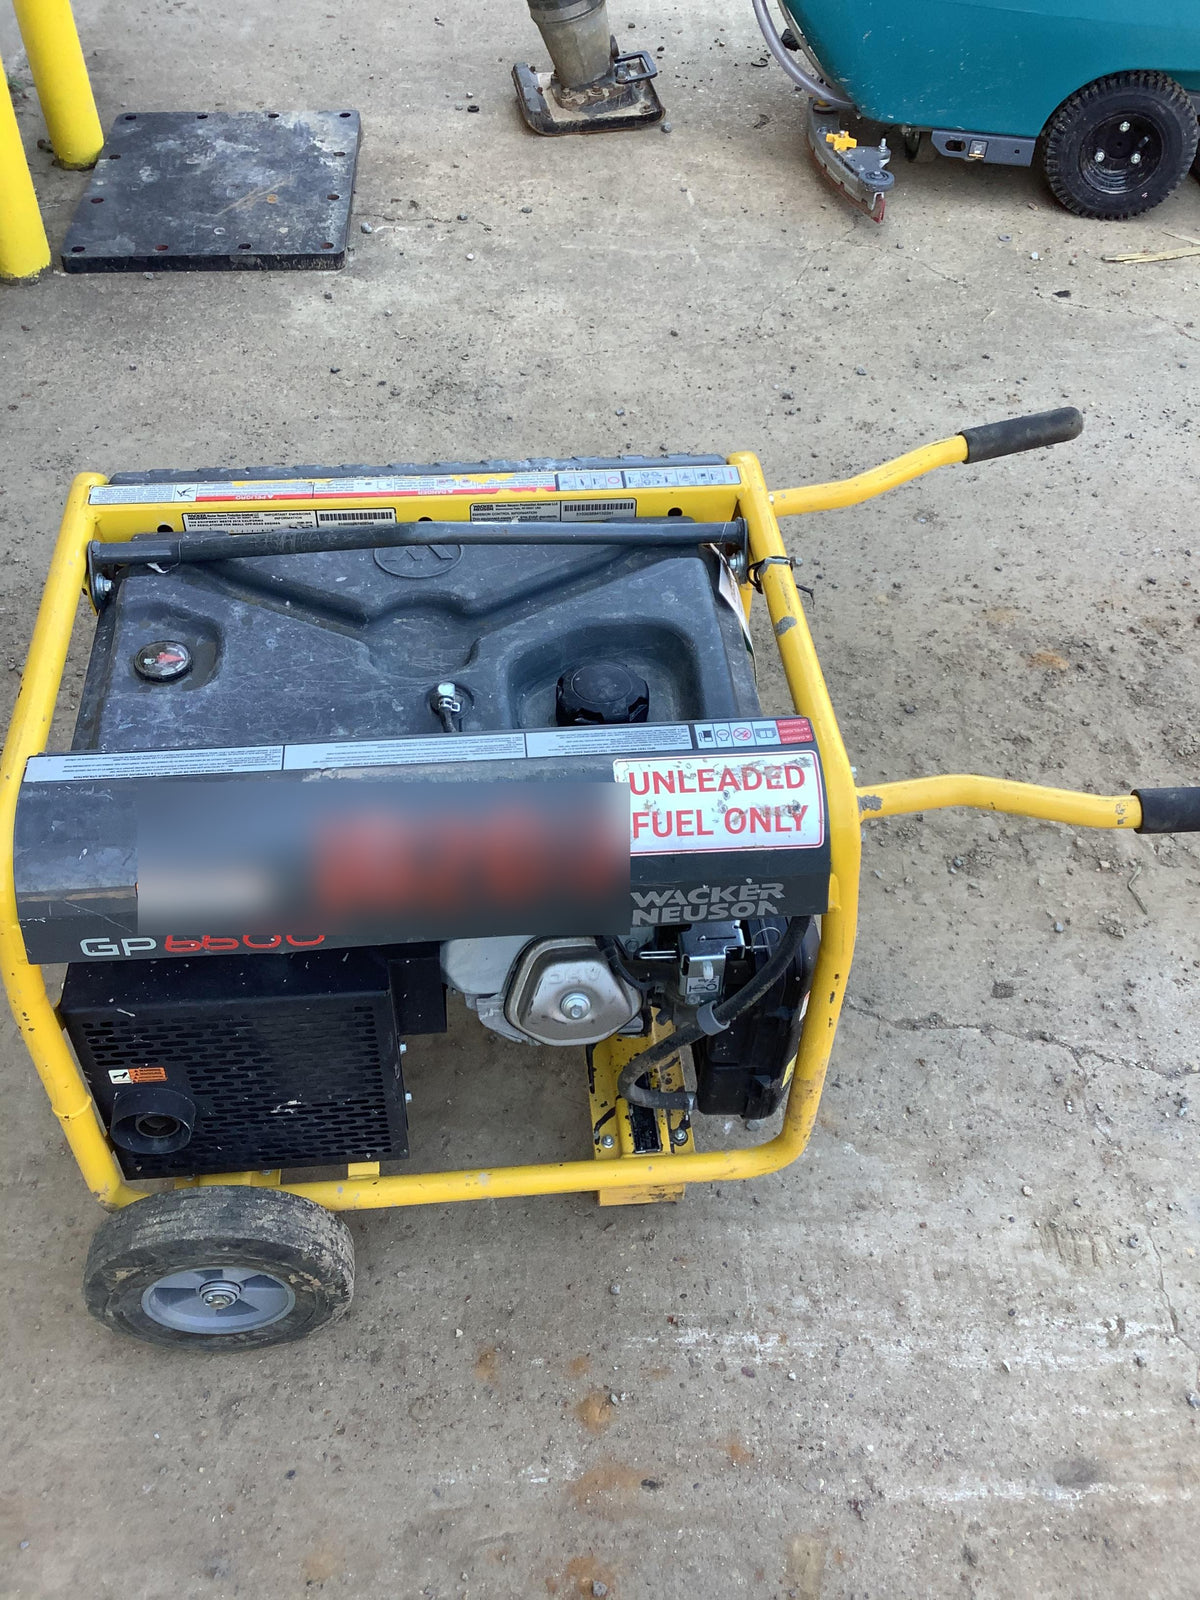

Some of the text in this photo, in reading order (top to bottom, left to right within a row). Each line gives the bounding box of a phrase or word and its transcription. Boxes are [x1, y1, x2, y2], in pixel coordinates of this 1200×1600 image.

[628, 764, 806, 796] UNLEADED
[632, 805, 809, 840] FUEL ONLY
[630, 882, 786, 908] WACKER
[632, 900, 780, 925] NEUSON
